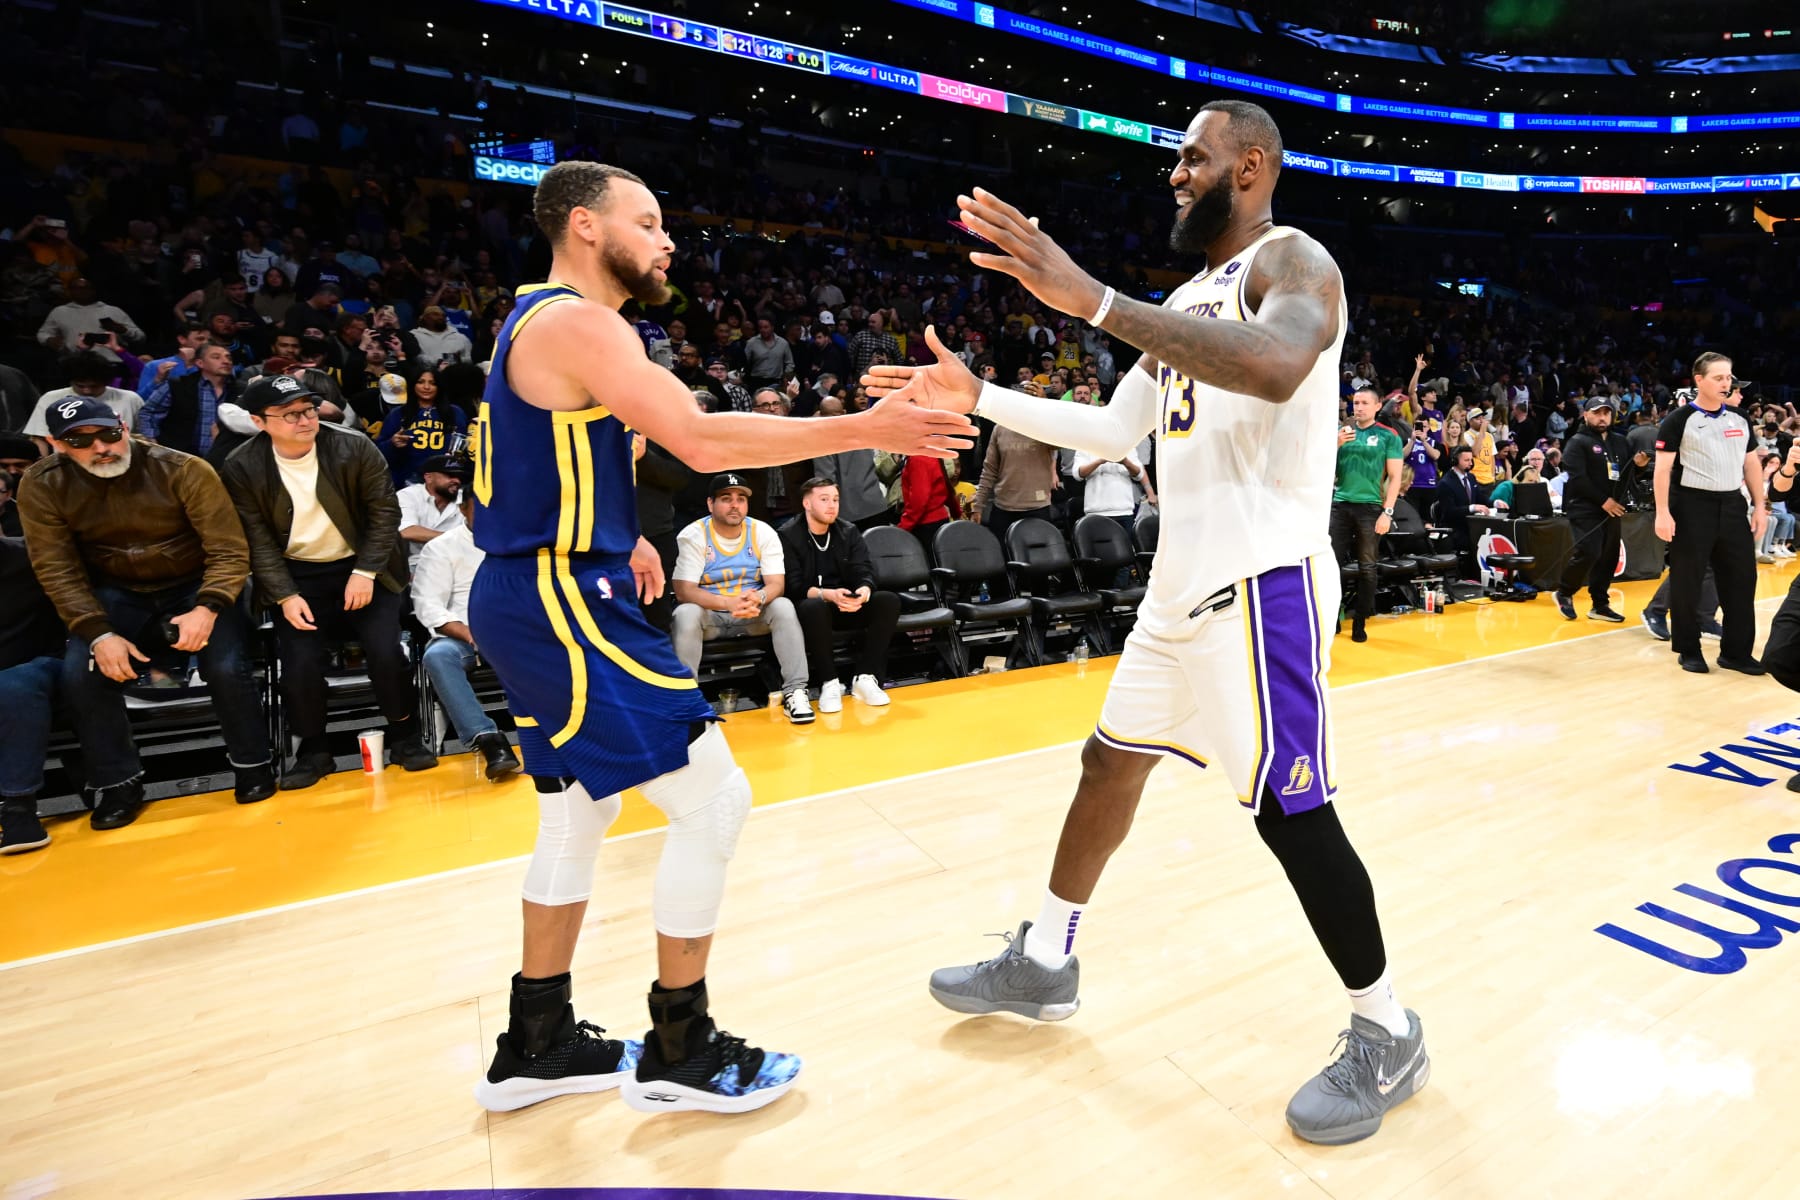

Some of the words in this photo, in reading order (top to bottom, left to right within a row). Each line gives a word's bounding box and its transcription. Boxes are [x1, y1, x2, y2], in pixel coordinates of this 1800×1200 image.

[508, 0, 592, 18] LTA
[611, 12, 643, 26] FOULS
[660, 22, 668, 34] 1
[693, 29, 703, 41] 5
[1010, 19, 1041, 34] LAKERS
[1042, 28, 1069, 41] GAMES
[1070, 35, 1085, 46] ARE
[1086, 39, 1113, 53] BETTER
[732, 39, 752, 53] 121
[763, 44, 784, 60] 128
[798, 52, 819, 67] 0.0
[831, 60, 870, 76] Michelob
[879, 70, 916, 87] ULTRA
[1198, 70, 1226, 82] LAKERS
[1227, 75, 1250, 87] GAMES
[1251, 81, 1263, 89] ARE
[1264, 83, 1287, 94] BETTER
[936, 80, 992, 104] boldyn
[1363, 102, 1388, 112] LAKERS
[1389, 106, 1411, 114] GAMES
[1426, 109, 1449, 118] BETTER
[1112, 121, 1144, 137] Sprite
[1701, 119, 1729, 127] LAKERS
[1282, 153, 1327, 170] Spectrum
[1352, 166, 1390, 177] crypto.com
[1410, 169, 1444, 177] AMERICAN
[1414, 176, 1444, 184] EXPRESS
[1463, 176, 1482, 185] UCLA
[1535, 180, 1575, 189] crypto.com
[1583, 180, 1642, 191] TOSHIBA
[1751, 179, 1780, 187] ULTRA
[412, 429, 445, 449] 30
[1418, 453, 1425, 464] 0
